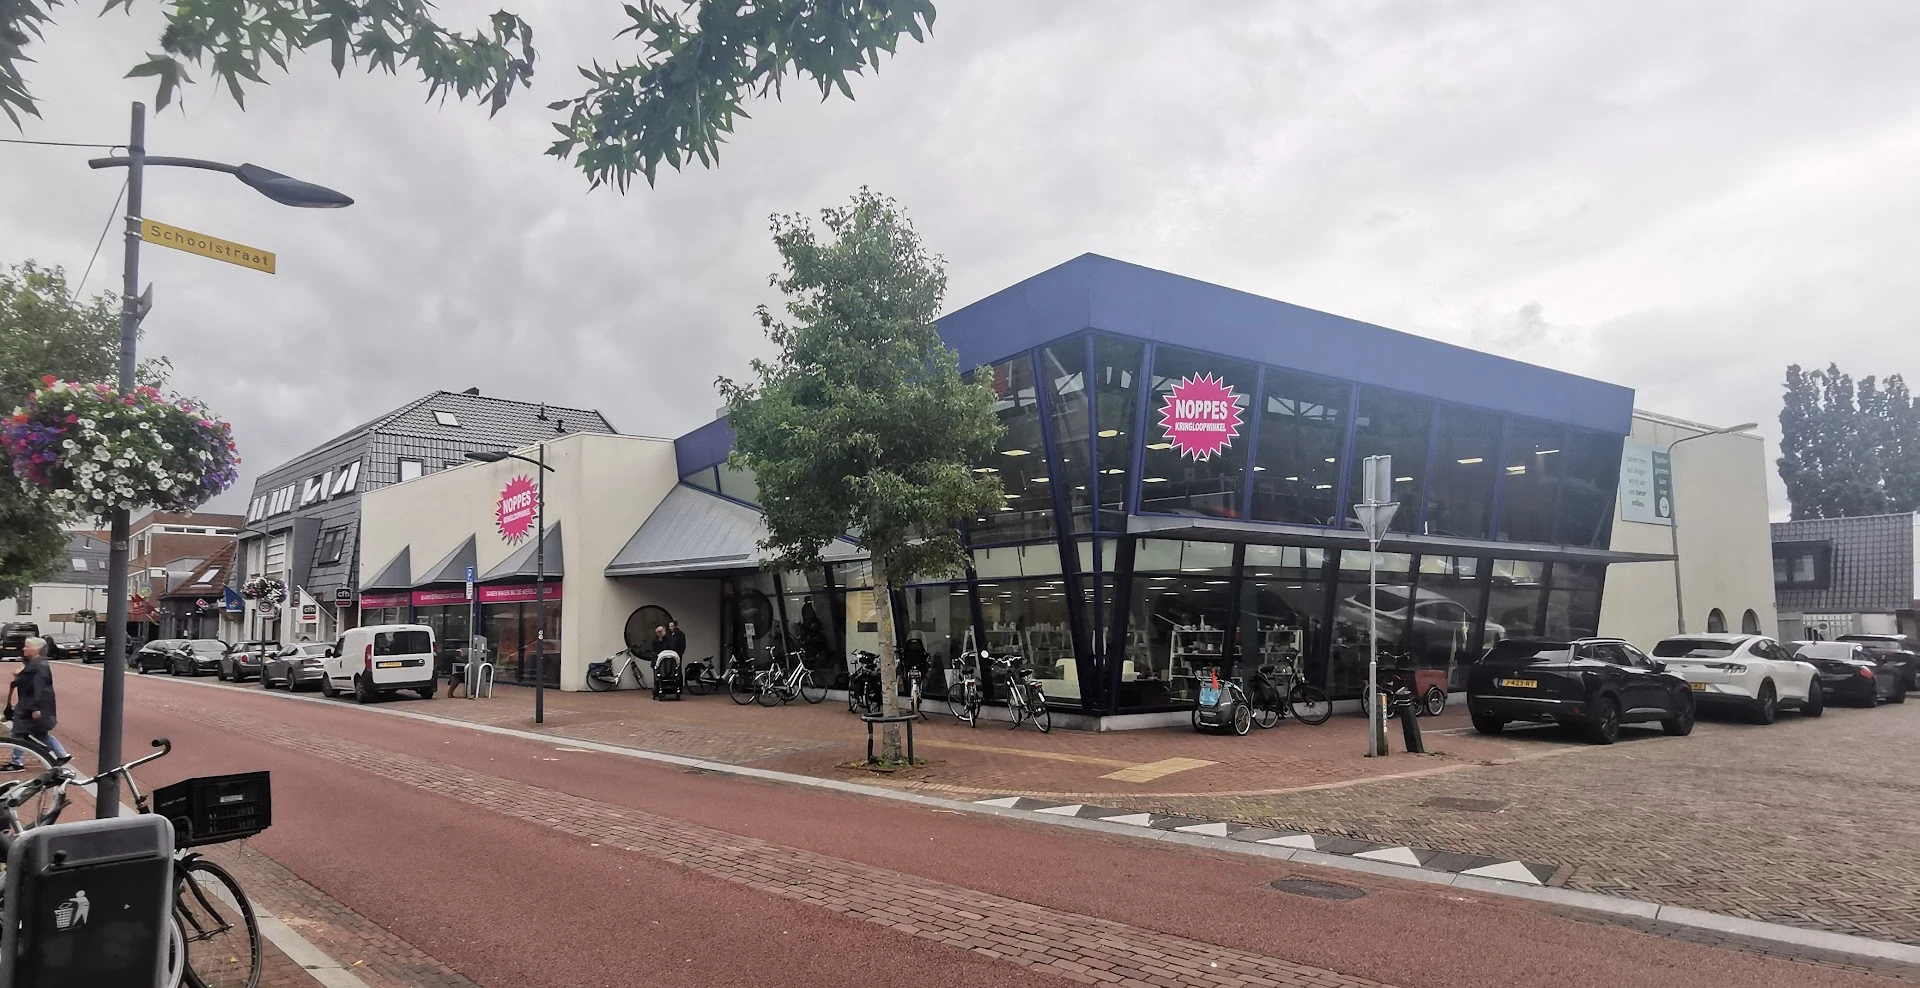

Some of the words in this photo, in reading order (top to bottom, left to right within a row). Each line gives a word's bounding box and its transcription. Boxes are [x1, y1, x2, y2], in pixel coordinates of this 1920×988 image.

[150, 225, 268, 266] Schoolstraat
[1175, 399, 1228, 420] NOPPES
[1175, 421, 1226, 432] KRINGLOOPWINKEL
[502, 490, 532, 514] NOPPES
